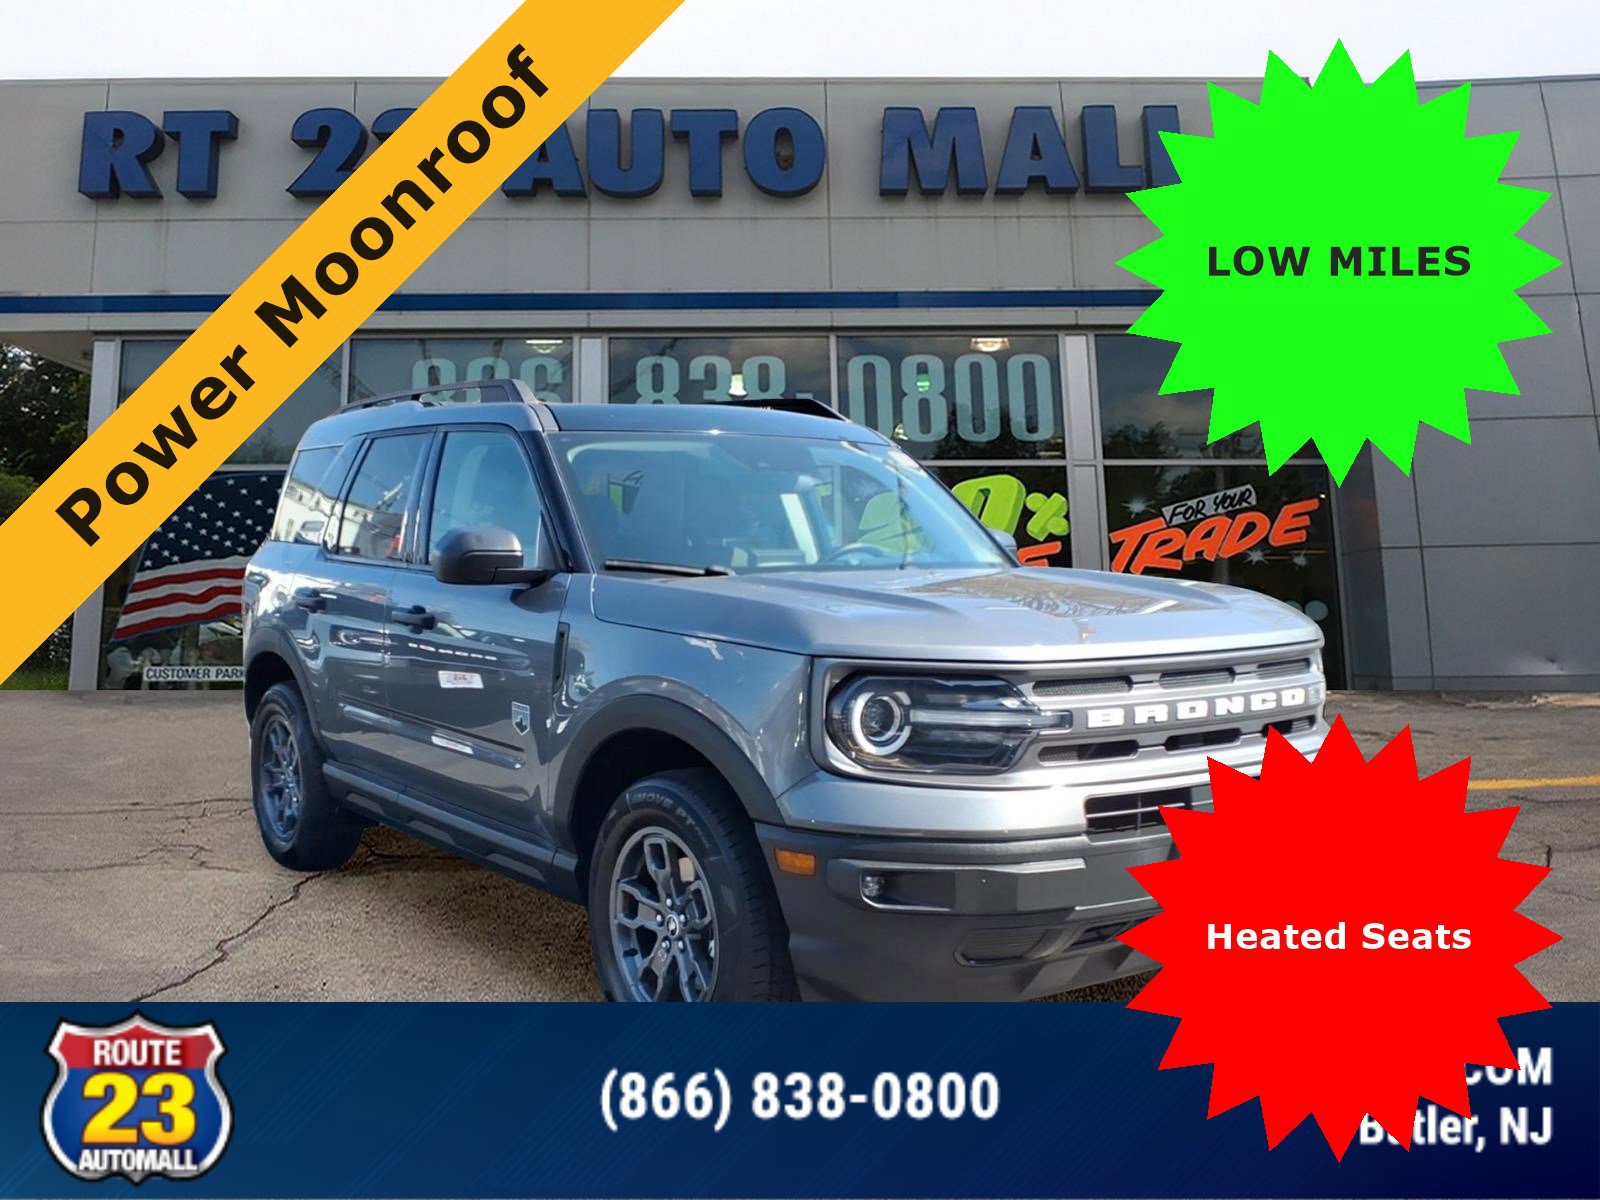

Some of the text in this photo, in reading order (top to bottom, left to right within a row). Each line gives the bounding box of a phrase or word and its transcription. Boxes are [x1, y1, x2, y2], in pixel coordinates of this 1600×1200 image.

[79, 109, 238, 200] RT
[502, 107, 826, 200] AUTO
[1168, 488, 1253, 525] FOR YOUR
[1109, 498, 1321, 575] TRADE
[145, 667, 211, 680] CUSTOMER
[1086, 687, 1306, 730] BRONCO
